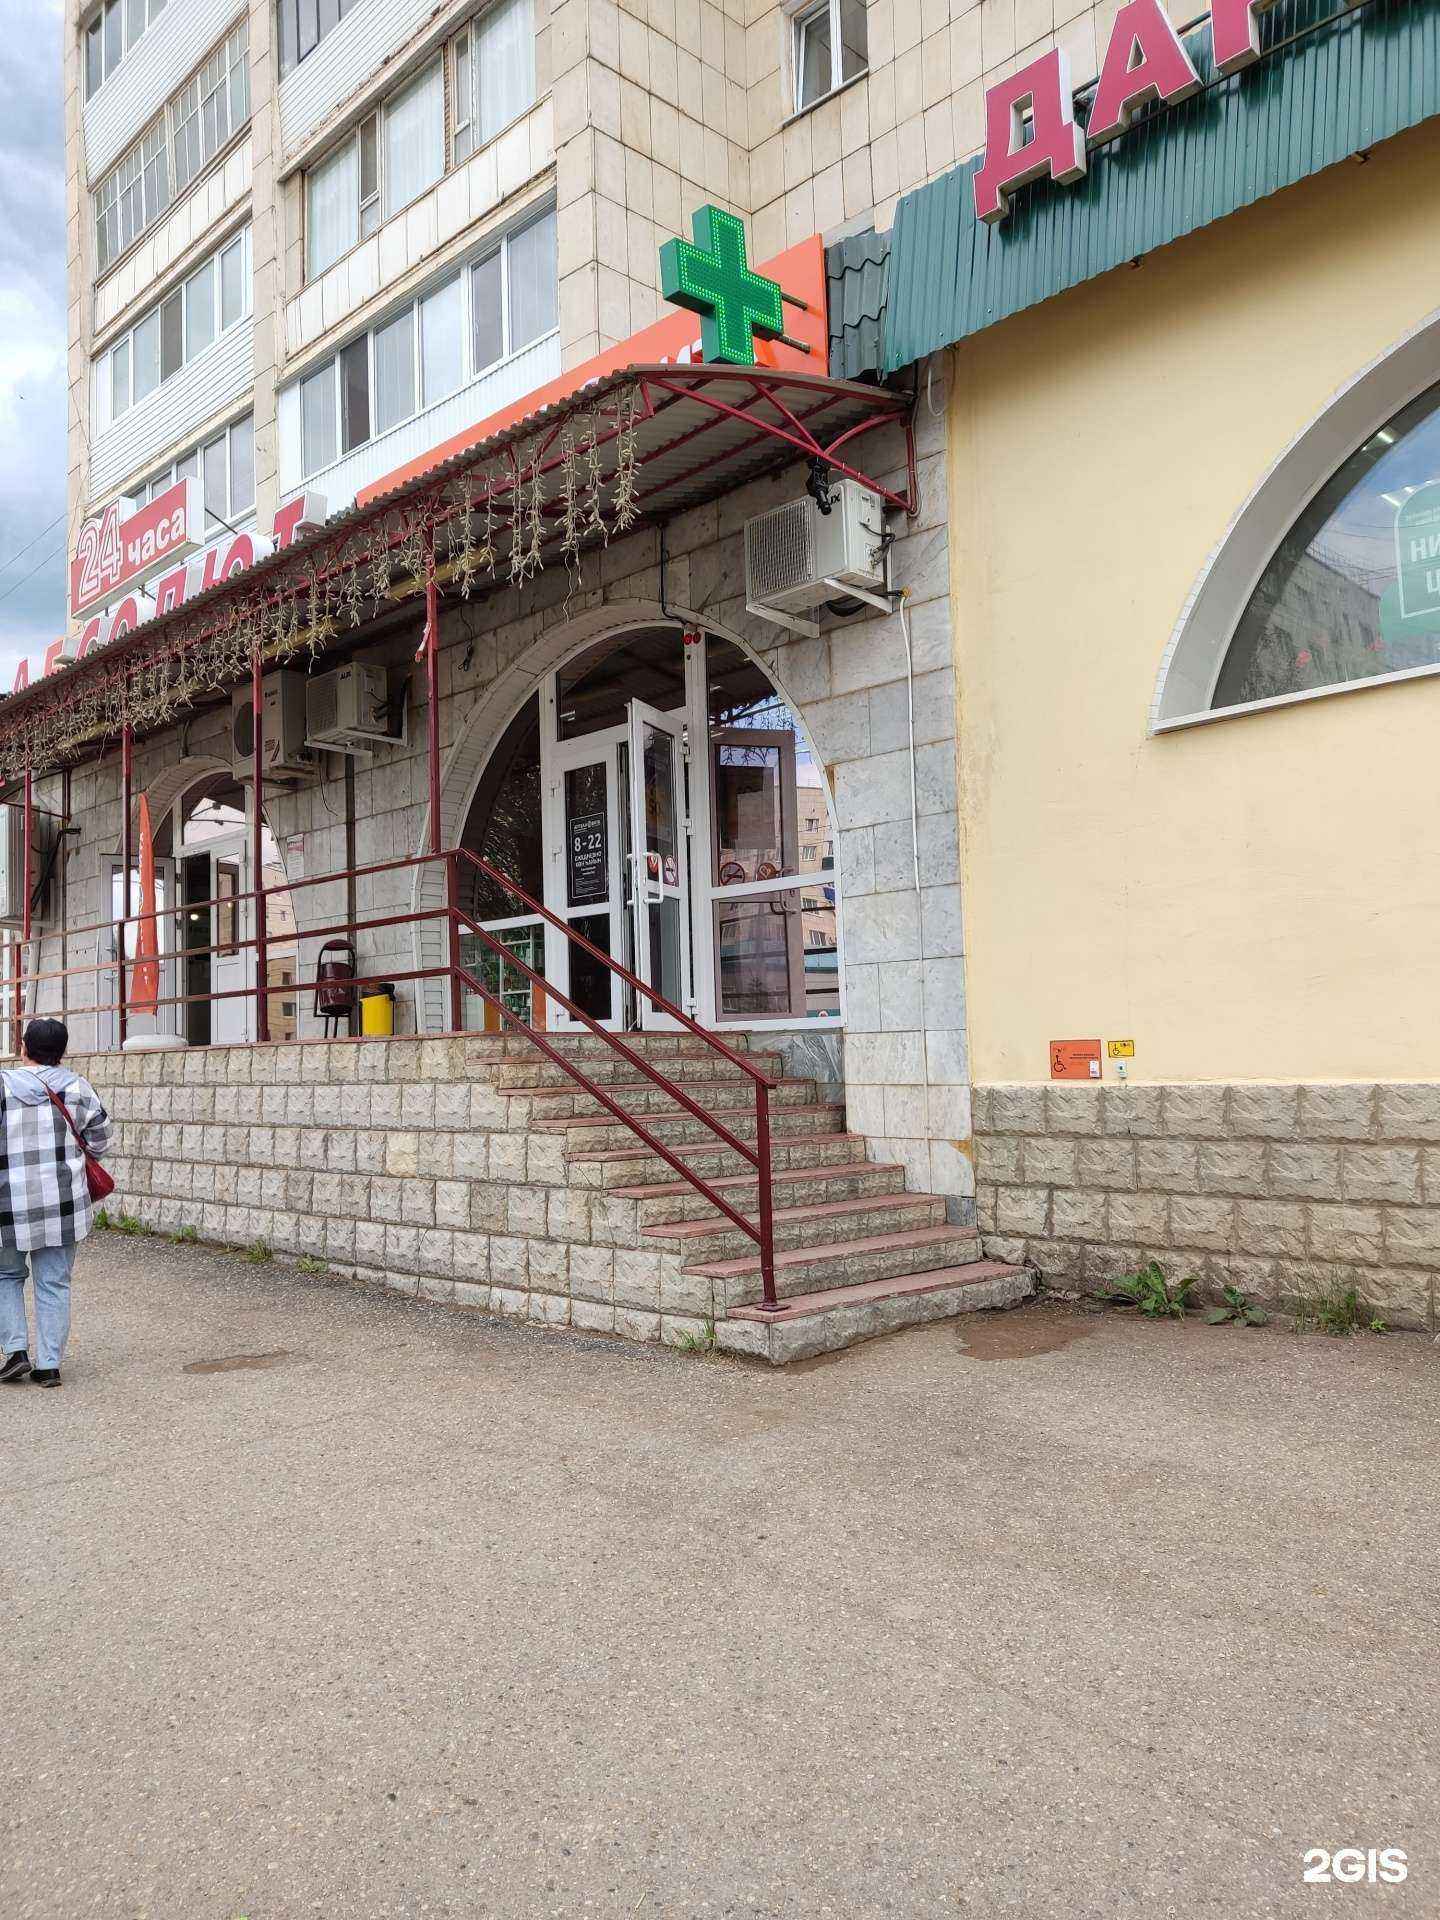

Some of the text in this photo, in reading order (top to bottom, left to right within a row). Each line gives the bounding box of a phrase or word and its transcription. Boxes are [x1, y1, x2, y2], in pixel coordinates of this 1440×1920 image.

[973, 0, 1256, 219] ДА
[78, 498, 186, 604] 24 часа
